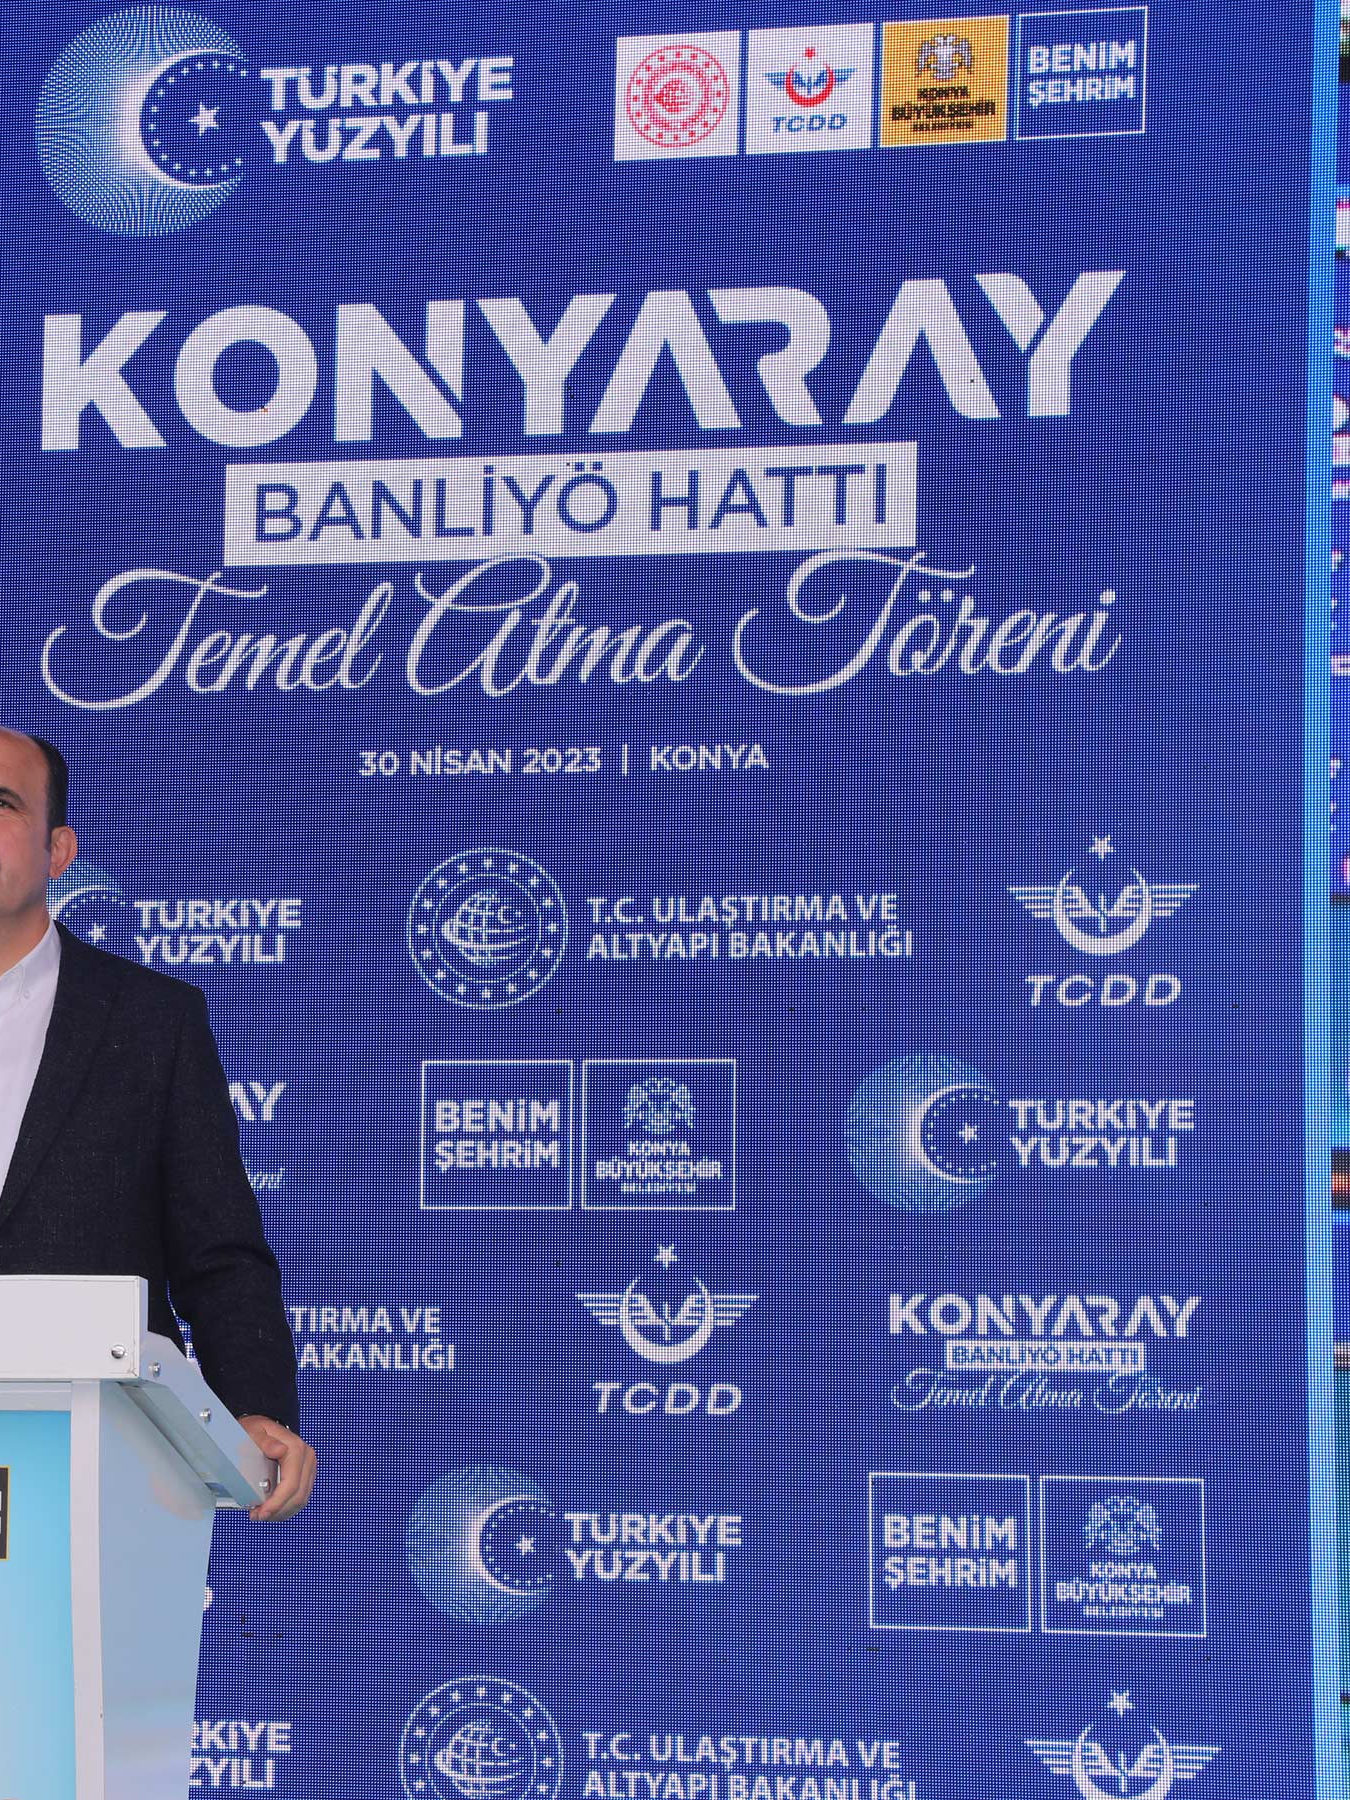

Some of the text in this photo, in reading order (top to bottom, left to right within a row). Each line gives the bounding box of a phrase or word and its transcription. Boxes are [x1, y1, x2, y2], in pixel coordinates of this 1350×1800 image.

[1028, 40, 1135, 74] BENİM
[916, 86, 970, 101] KONYA
[1028, 76, 1135, 110] ŞEHRİM
[771, 113, 847, 133] TCDD
[41, 270, 1126, 450] KONYARAY
[255, 461, 888, 543] BANLİYÖ HATTI
[42, 551, 1121, 709] Temel Atma Töreni
[359, 744, 769, 776] 30 NİSAN 2023 KONYA
[587, 893, 897, 927] T.C. ULAŞTIRMA VE
[587, 927, 912, 960] ALTYAPI BAKANLIĞI
[1025, 974, 1181, 1006] TCDD
[435, 1098, 559, 1133] BENİM
[434, 1138, 558, 1173] ŞEHRİM
[628, 1141, 690, 1156] KONYA
[290, 1306, 440, 1334] TIRMA VE
[889, 1294, 1201, 1337] KONYARAY
[298, 1340, 455, 1369] AKANLIĞI
[952, 1343, 1138, 1367] BANLİYÖ HATTI
[592, 1383, 742, 1415] TCDD
[884, 1515, 1016, 1550] BENİM
[884, 1555, 1017, 1590] ŞEHRİM
[1090, 1561, 1156, 1580] KONYA
[583, 1732, 900, 1771] T.C. ULAŞTIRMA VE
[583, 1770, 916, 1800] ALTYAPI BAKANLIĞI
